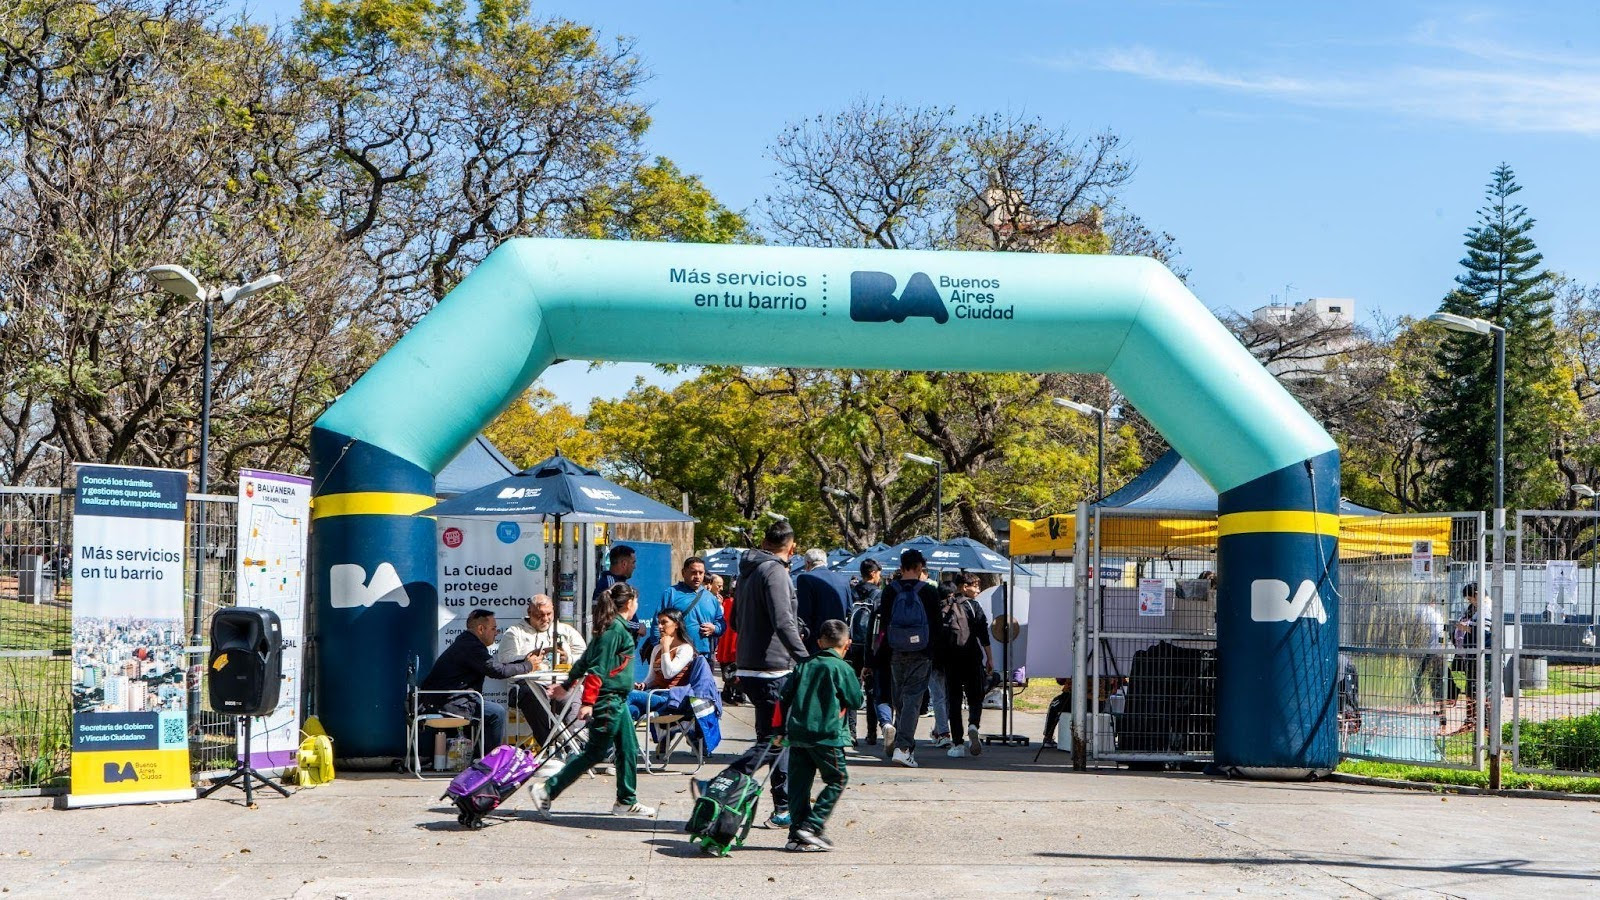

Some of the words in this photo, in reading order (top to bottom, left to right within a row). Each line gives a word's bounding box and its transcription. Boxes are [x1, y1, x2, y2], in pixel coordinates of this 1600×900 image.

[669, 268, 711, 284] Más
[716, 271, 807, 287] servicios
[939, 275, 1000, 288] Buenos
[694, 293, 718, 307] en
[724, 291, 742, 308] tu
[748, 291, 807, 310] barrio
[849, 270, 949, 325] BA
[950, 290, 995, 304] Aires
[955, 305, 1014, 320] Ciudad
[82, 476, 111, 485] Conocé
[112, 478, 123, 486] los
[124, 478, 153, 488] trámites
[82, 488, 88, 496] y
[88, 487, 124, 496] gestiones
[124, 490, 138, 498] que
[138, 490, 161, 499] podés
[257, 483, 296, 496] BALVANERA
[82, 497, 110, 506] realizar
[110, 498, 120, 506] de
[120, 499, 141, 508] forma
[142, 501, 178, 510] presencial
[81, 545, 113, 560] Más
[116, 548, 180, 563] servicios
[81, 566, 100, 579] en
[104, 565, 117, 579] tu
[121, 565, 164, 580] barrio
[444, 565, 460, 576] La
[464, 564, 512, 576] Ciudad
[329, 561, 411, 609] BA
[444, 580, 498, 594] protege
[444, 596, 465, 607] tus
[469, 595, 532, 607] Derechos
[1250, 578, 1328, 625] BA
[79, 723, 114, 732] Secretaría
[114, 723, 123, 731] de
[123, 723, 154, 731] Gobierno
[110, 733, 146, 741] Ciudadano
[103, 761, 139, 783] BA
